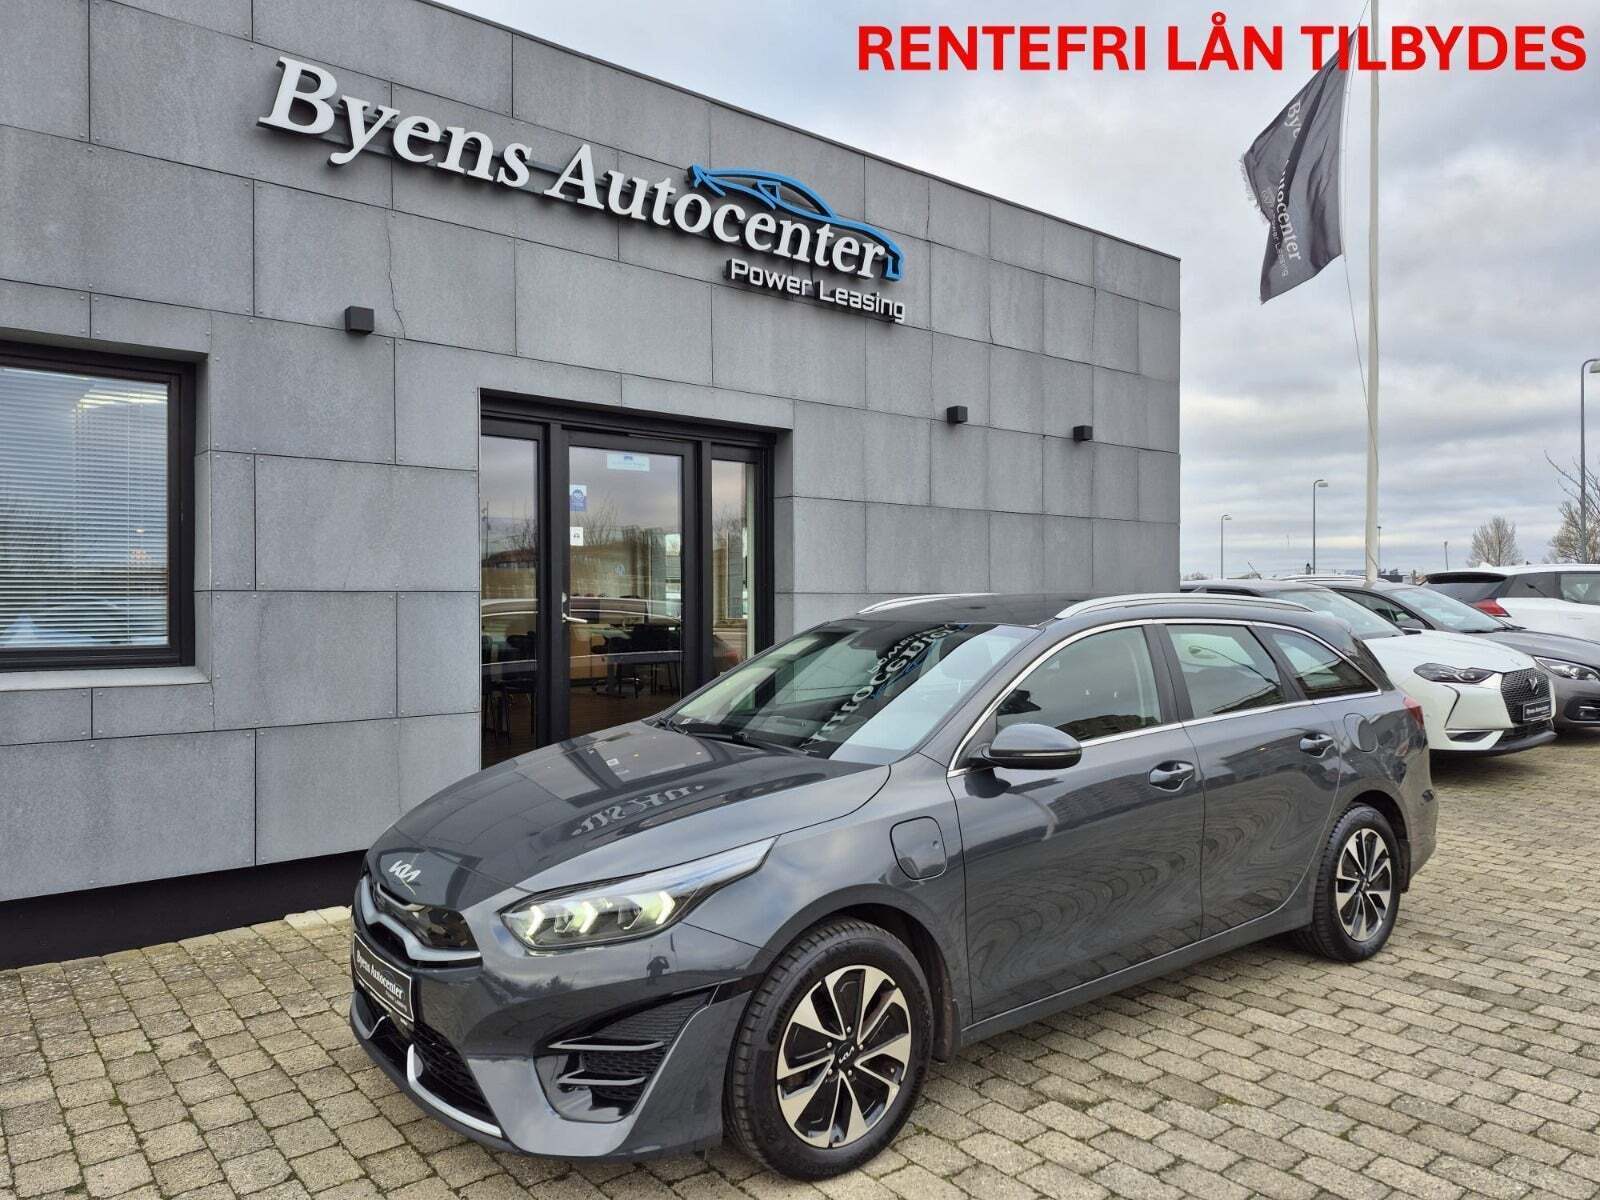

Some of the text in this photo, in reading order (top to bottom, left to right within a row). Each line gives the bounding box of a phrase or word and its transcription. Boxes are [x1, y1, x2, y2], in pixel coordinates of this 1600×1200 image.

[259, 55, 886, 279] Byens Autocenter
[731, 258, 906, 324] Power Leasing
[370, 963, 403, 1000] Autocenter
